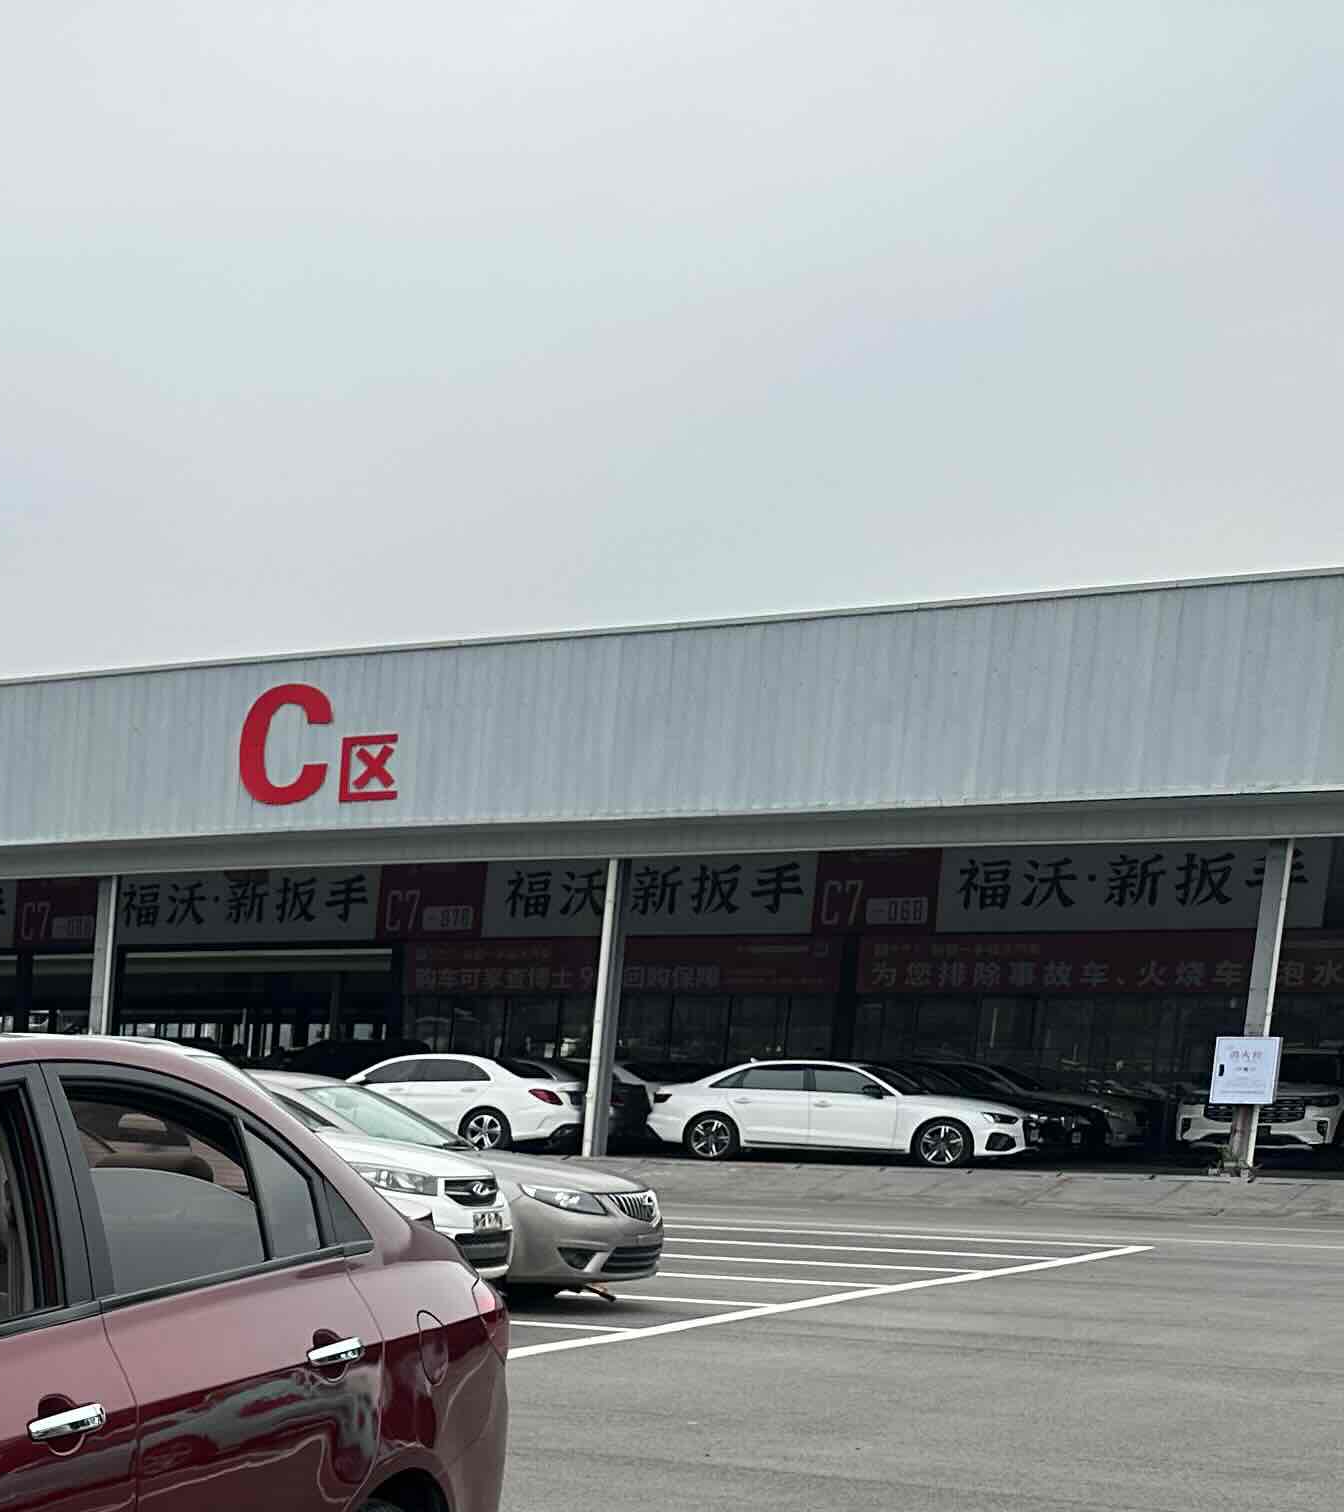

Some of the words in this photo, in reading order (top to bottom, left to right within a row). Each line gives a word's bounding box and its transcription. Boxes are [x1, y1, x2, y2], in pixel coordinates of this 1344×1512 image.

[239, 683, 399, 806] C区
[121, 875, 368, 927] 福沃·新扳手
[506, 863, 803, 918] 福沃新扳手
